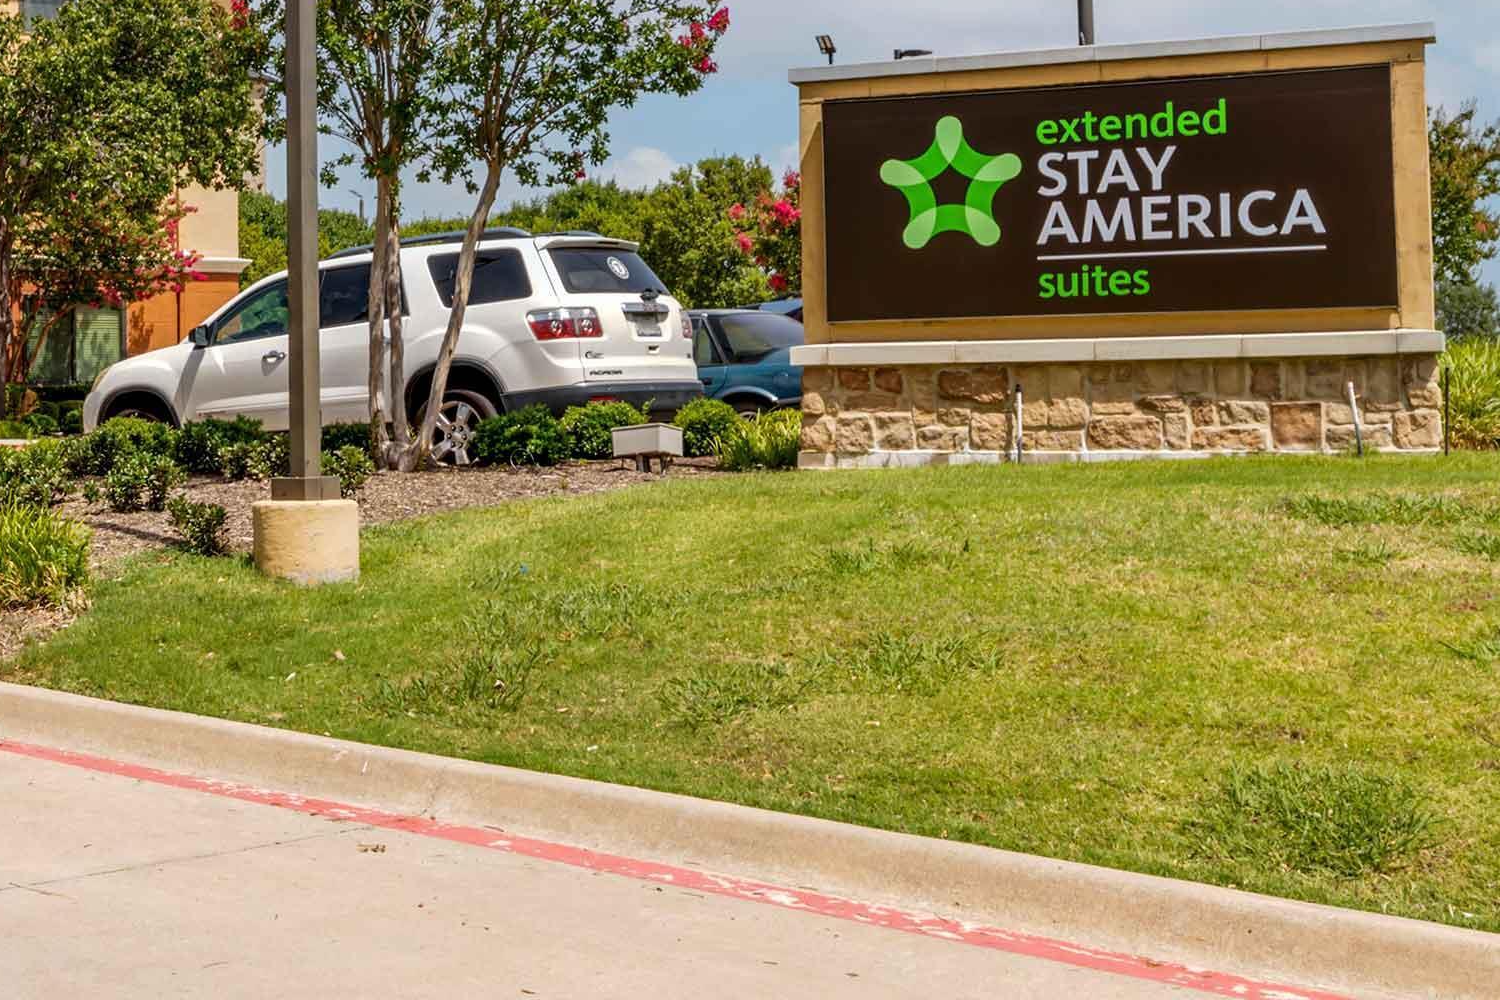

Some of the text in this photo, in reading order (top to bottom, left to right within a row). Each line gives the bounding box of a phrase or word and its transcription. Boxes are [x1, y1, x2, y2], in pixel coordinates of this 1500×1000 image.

[1036, 98, 1227, 144] extended
[1037, 145, 1177, 196] STAY
[1037, 188, 1327, 245] AMERICA
[1038, 264, 1150, 298] suites
